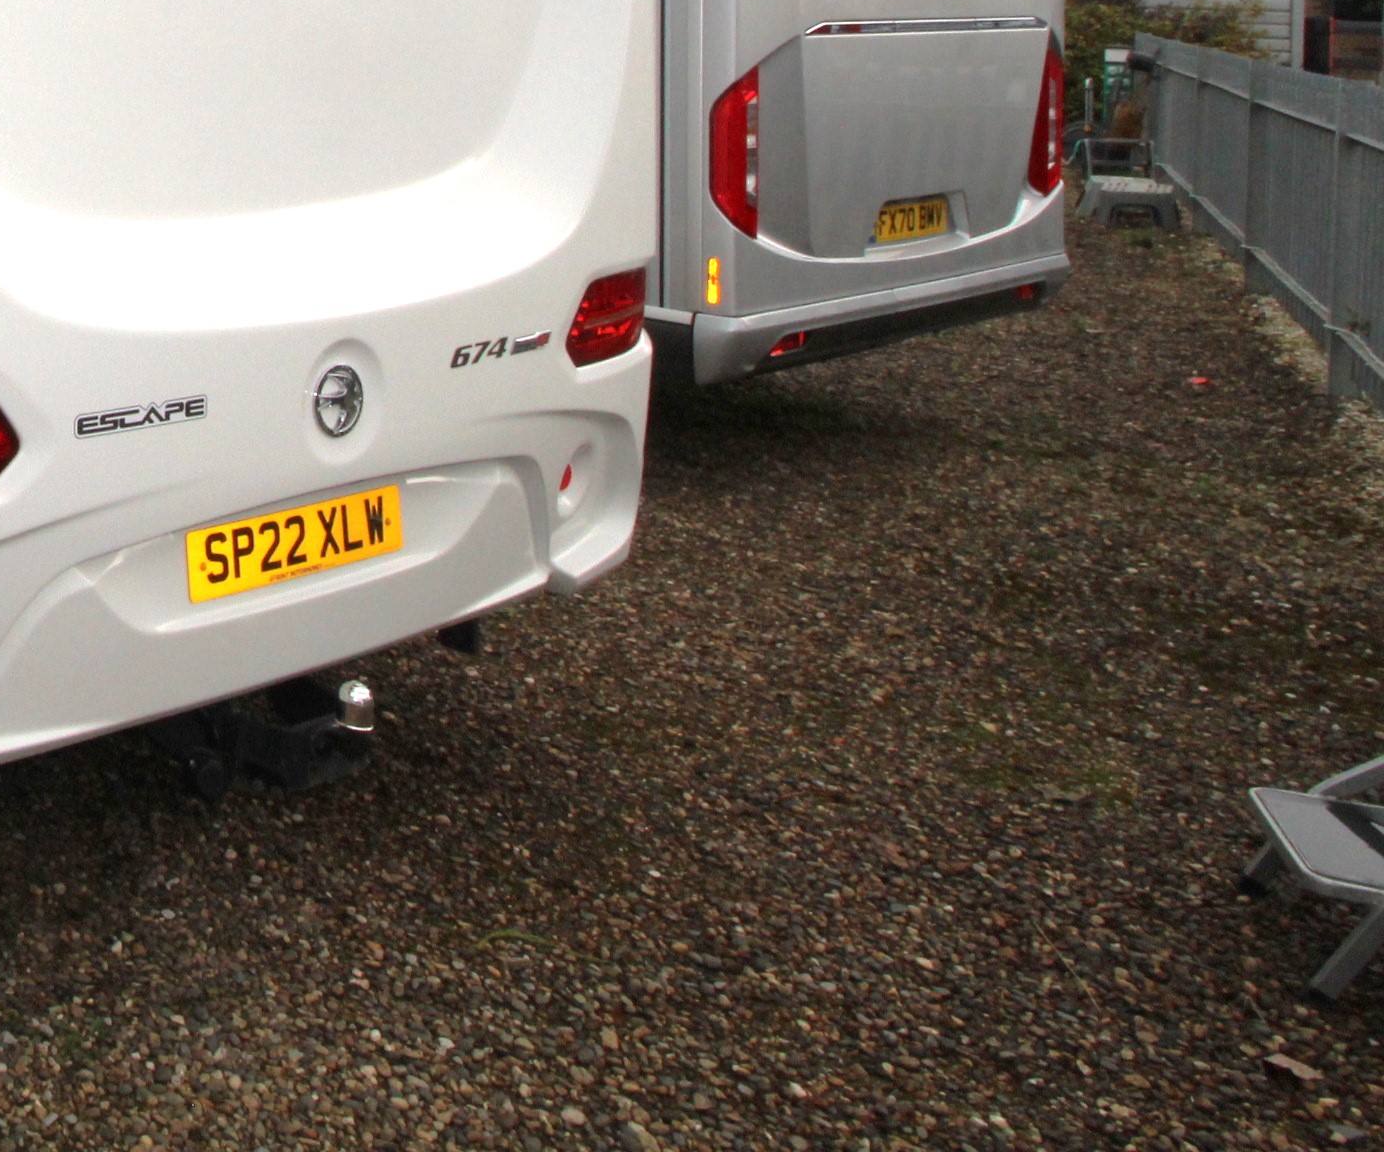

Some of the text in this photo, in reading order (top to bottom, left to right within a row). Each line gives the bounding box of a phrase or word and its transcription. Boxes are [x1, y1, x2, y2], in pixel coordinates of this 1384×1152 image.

[450, 336, 508, 369] 674
[77, 397, 206, 436] ESCAPE
[204, 495, 385, 584] SP22 XLW
